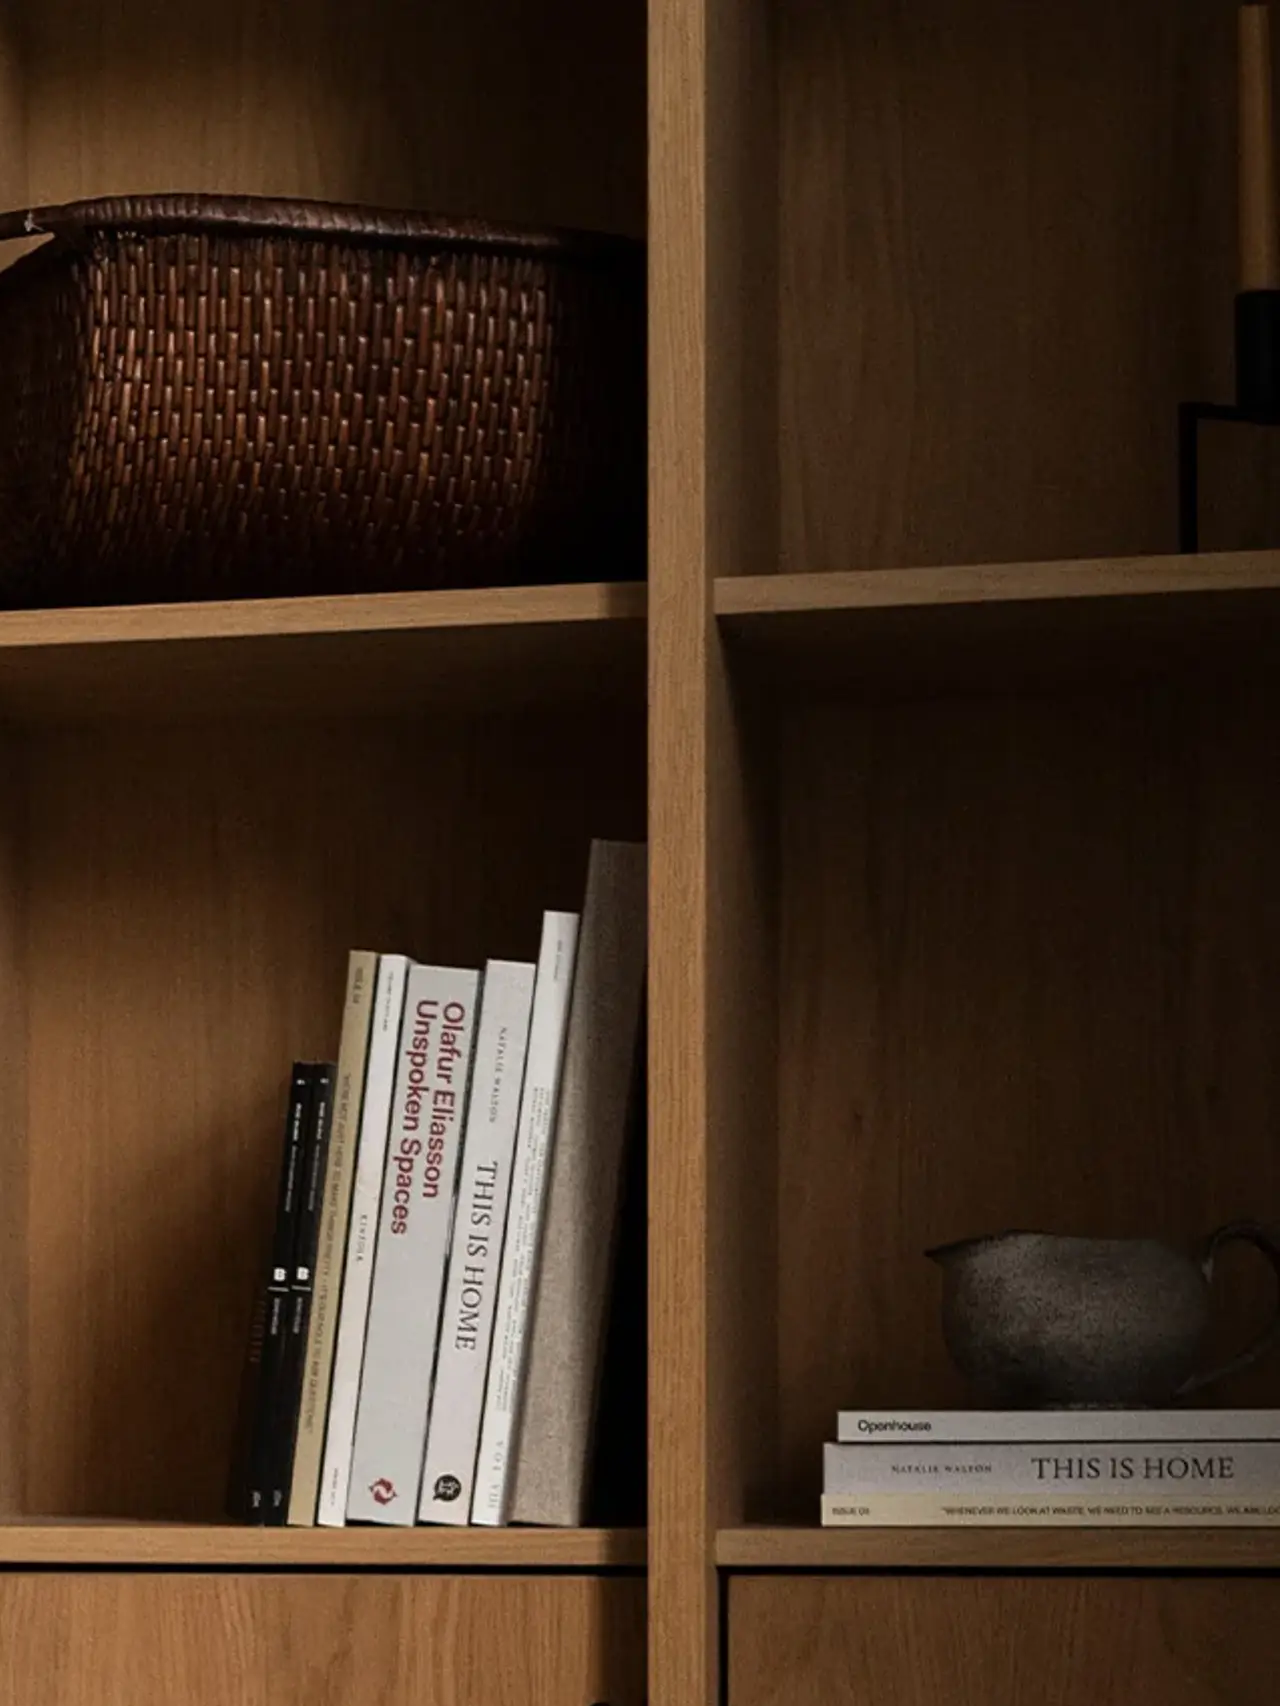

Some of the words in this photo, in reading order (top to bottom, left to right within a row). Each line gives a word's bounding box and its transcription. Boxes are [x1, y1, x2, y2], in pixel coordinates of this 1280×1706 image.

[402, 1000, 439, 1132] Unspoken
[437, 1002, 466, 1084] Olafur
[422, 1090, 455, 1199] Eliasson
[391, 1138, 421, 1236] Spaces
[471, 1161, 499, 1226] THIS
[467, 1233, 489, 1259] IS
[455, 1264, 484, 1351] HOME
[857, 1418, 932, 1434] Openhouse
[892, 1464, 939, 1474] NATALIE
[944, 1464, 992, 1474] WALTON
[1031, 1456, 1100, 1480] THIS
[1109, 1457, 1134, 1480] IS
[1143, 1456, 1235, 1480] HOME
